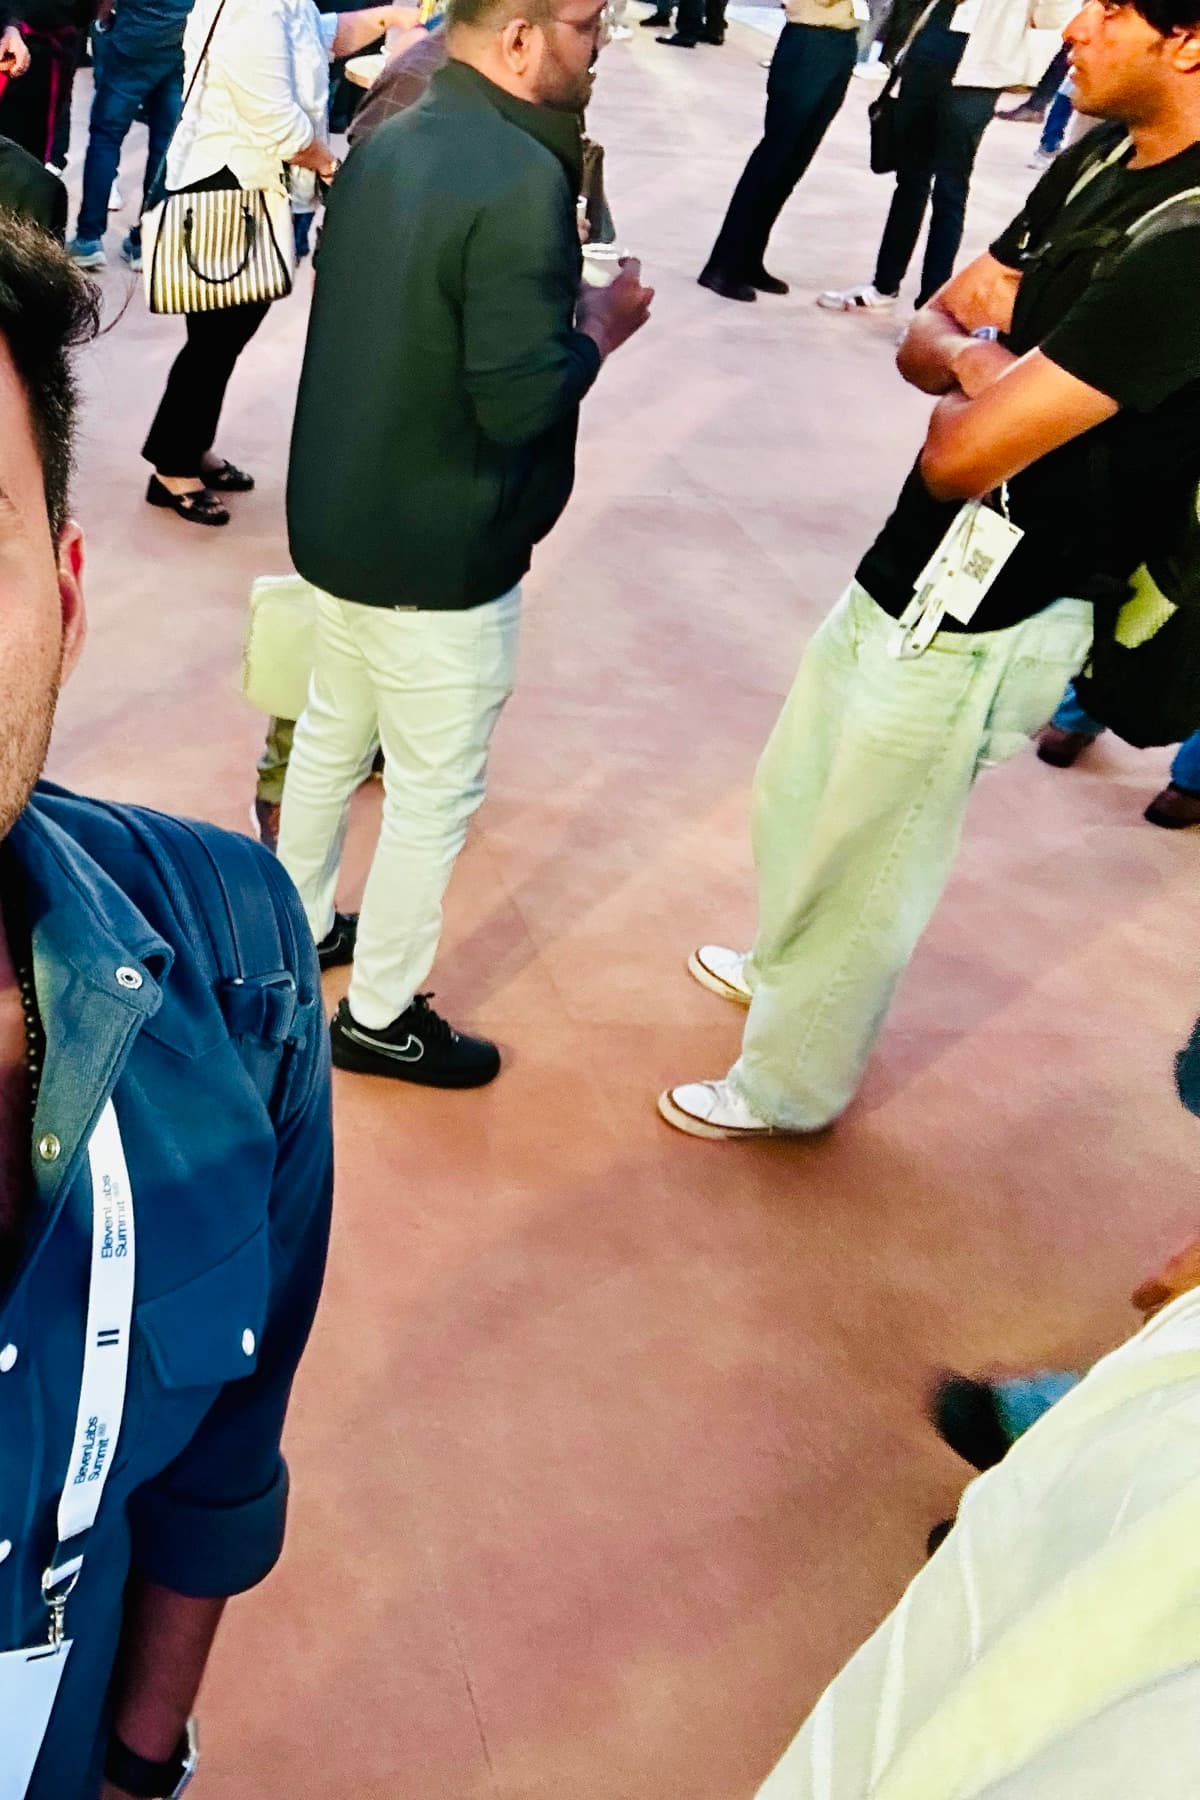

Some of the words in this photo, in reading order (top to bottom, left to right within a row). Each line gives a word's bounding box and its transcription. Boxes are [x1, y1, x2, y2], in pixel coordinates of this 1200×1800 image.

[115, 1200, 127, 1257] Summit
[73, 1416, 98, 1485] ElevenLabs
[88, 1438, 109, 1482] Summit
